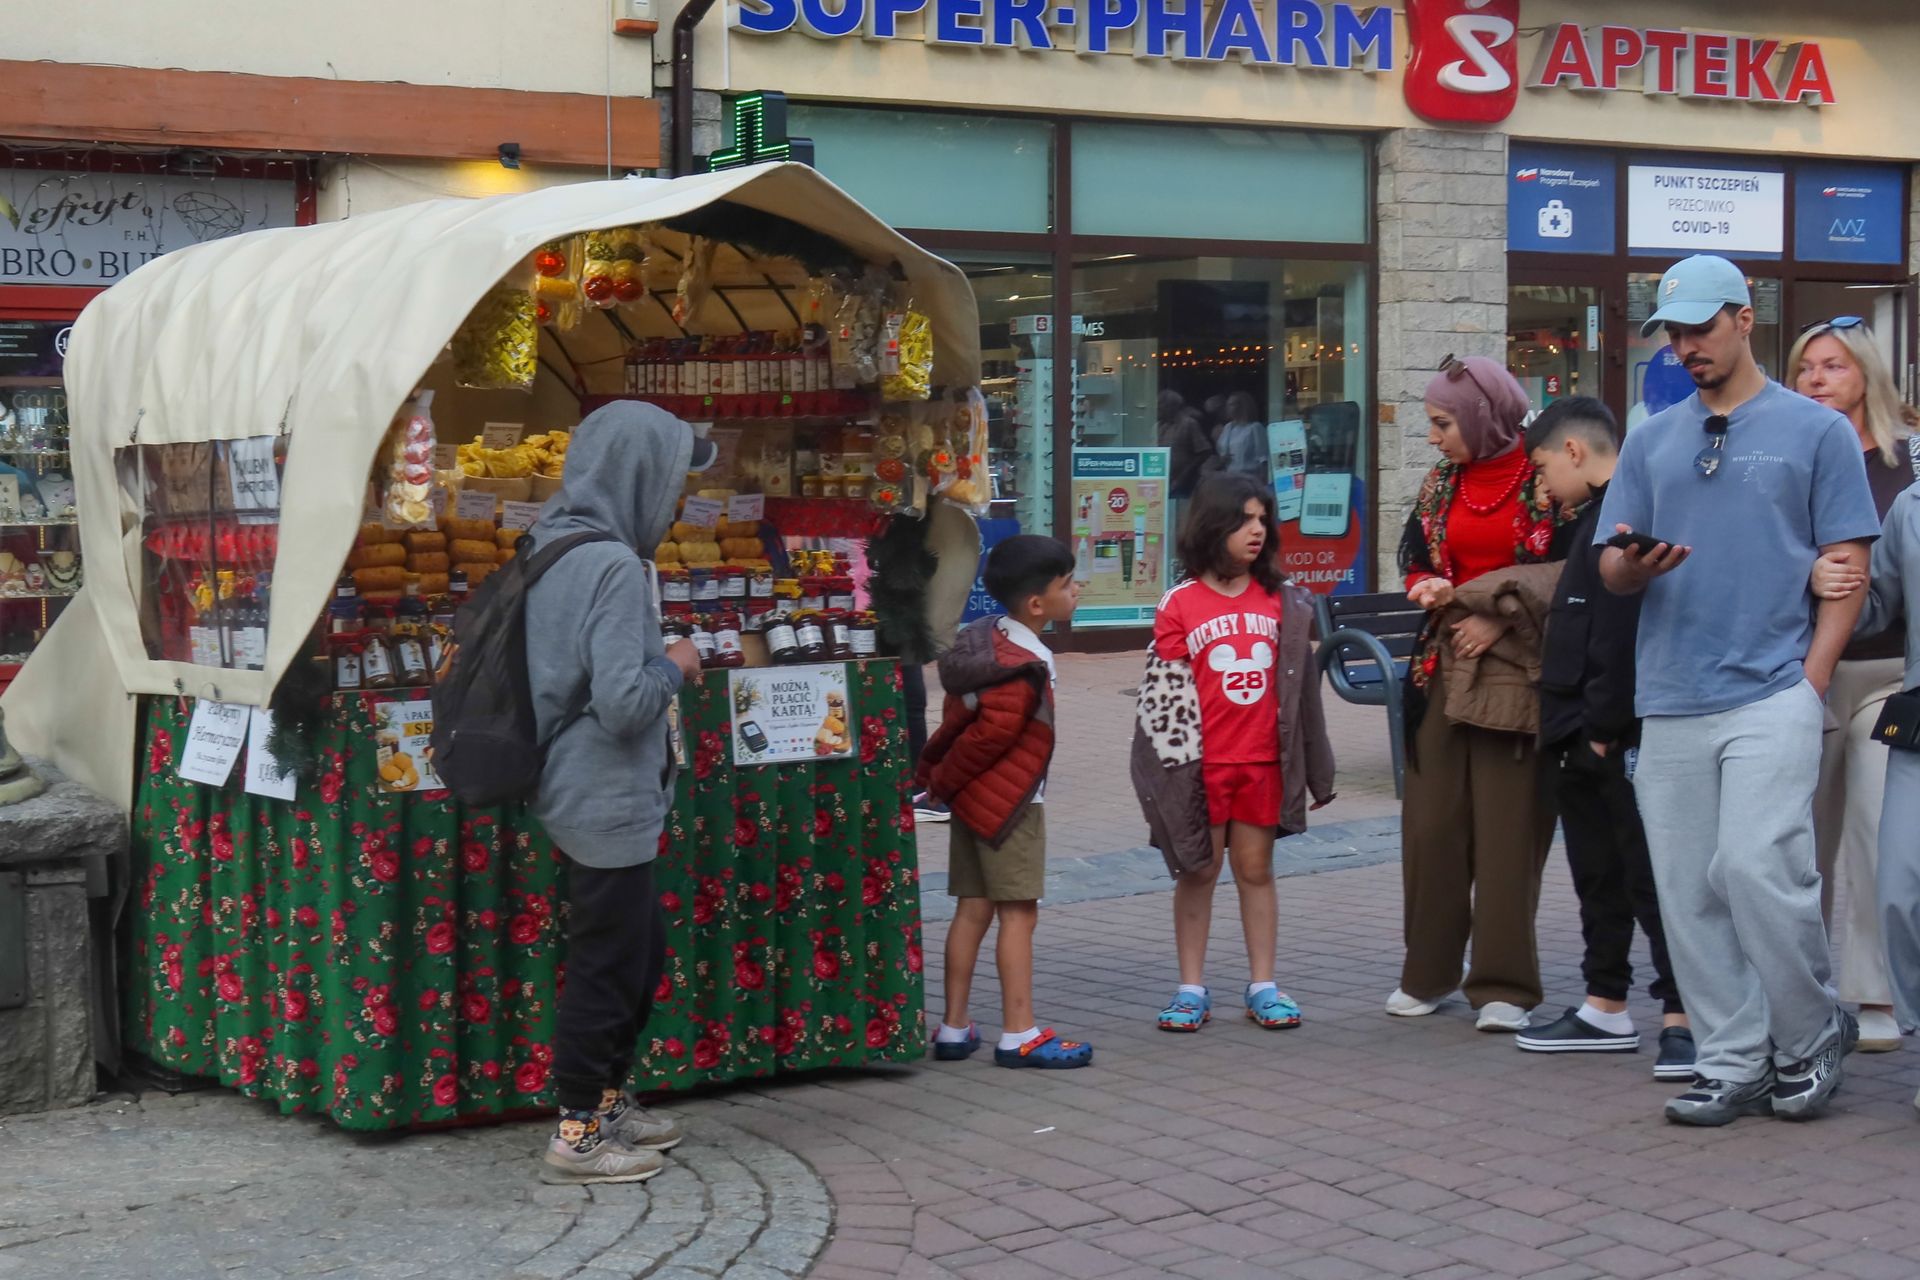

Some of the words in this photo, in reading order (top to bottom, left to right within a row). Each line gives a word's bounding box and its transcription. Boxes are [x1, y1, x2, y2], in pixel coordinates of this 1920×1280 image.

[1540, 23, 1836, 105] APTEKA
[1654, 175, 1694, 189] PUNKT
[1697, 176, 1759, 192] SZCZEPIEŃ
[1668, 198, 1735, 213] PRZECIWKO
[1672, 220, 1729, 234] COVID-19
[1285, 552, 1313, 565] KOD
[1316, 551, 1335, 564] QR
[1185, 613, 1240, 660] MICKEY
[1243, 612, 1278, 645] MOU
[1226, 671, 1263, 690] 28
